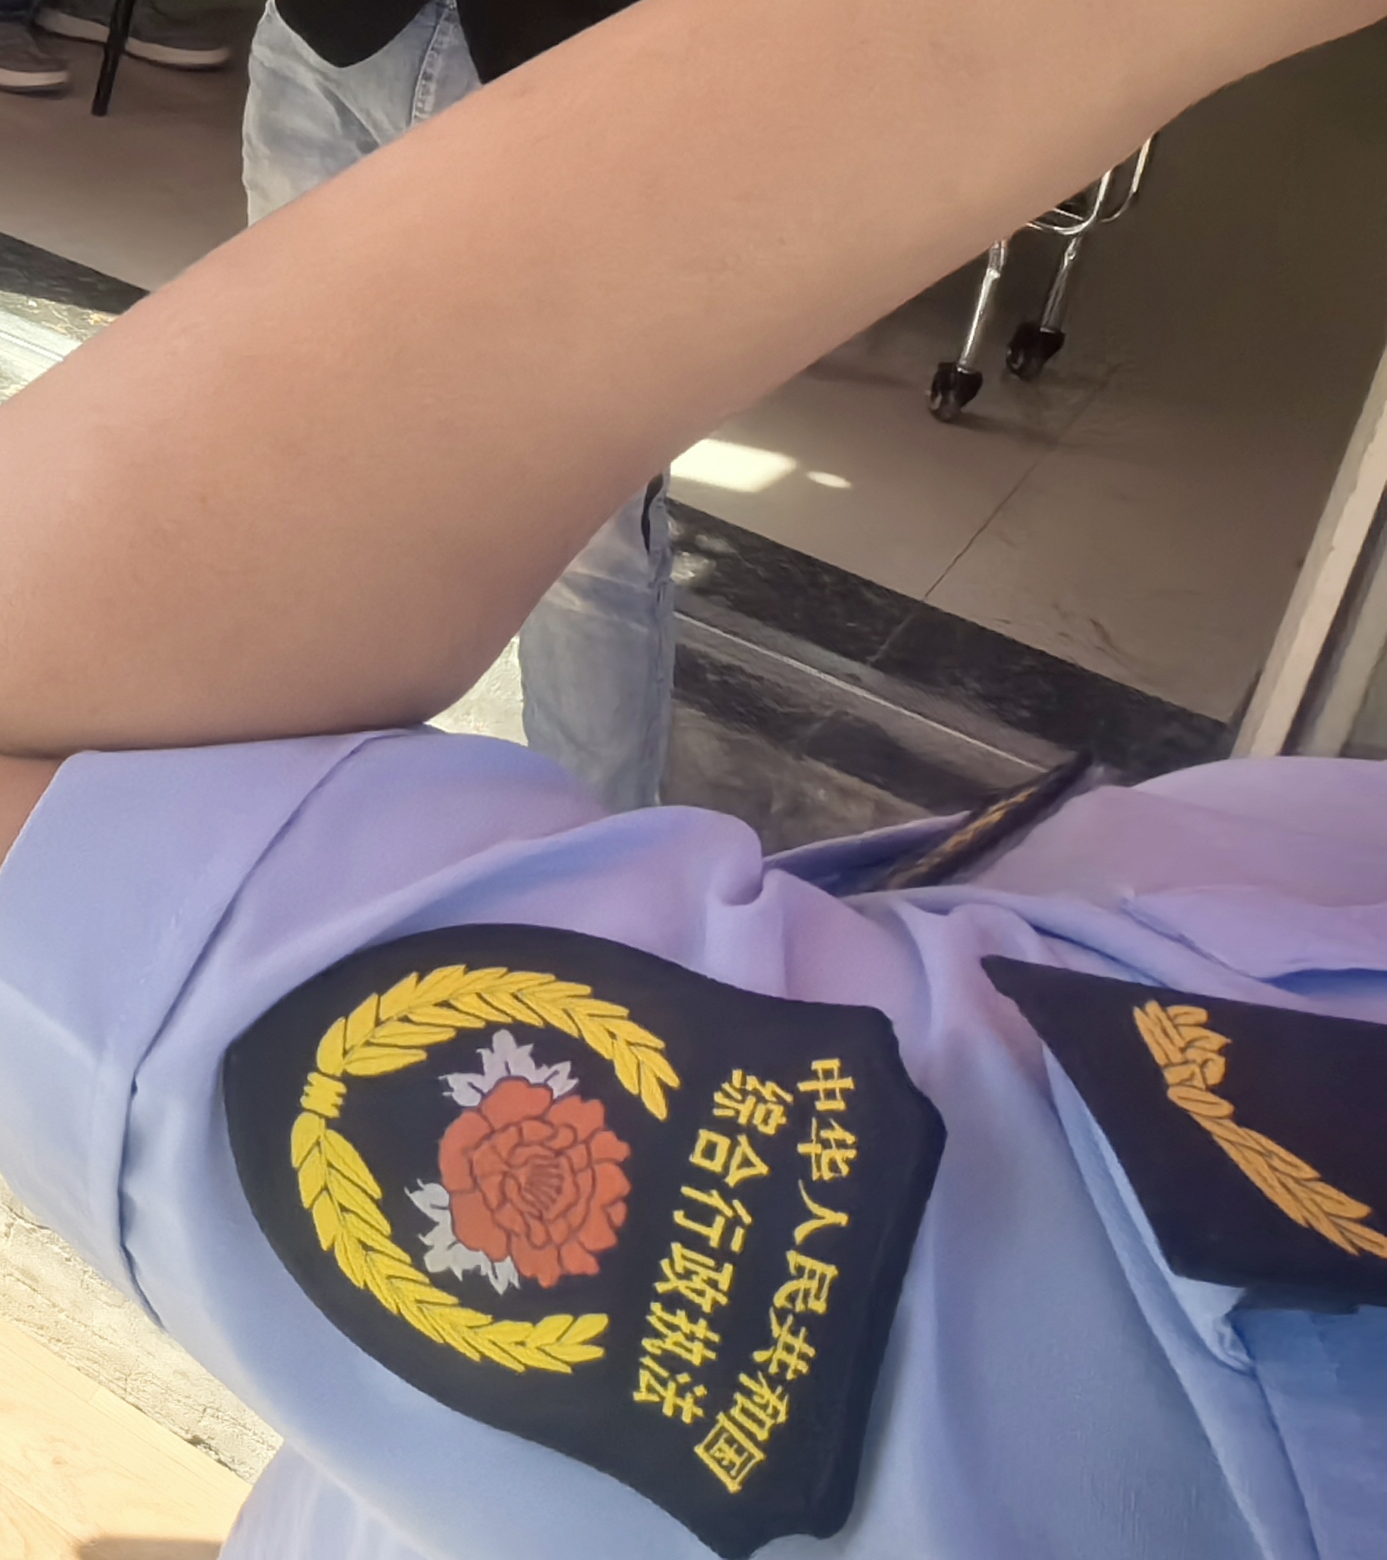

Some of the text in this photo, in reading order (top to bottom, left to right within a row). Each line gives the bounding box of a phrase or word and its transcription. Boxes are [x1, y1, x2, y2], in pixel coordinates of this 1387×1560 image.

[632, 1068, 794, 1425] 综合行政执法
[694, 1057, 858, 1494] 中华人民共和国
